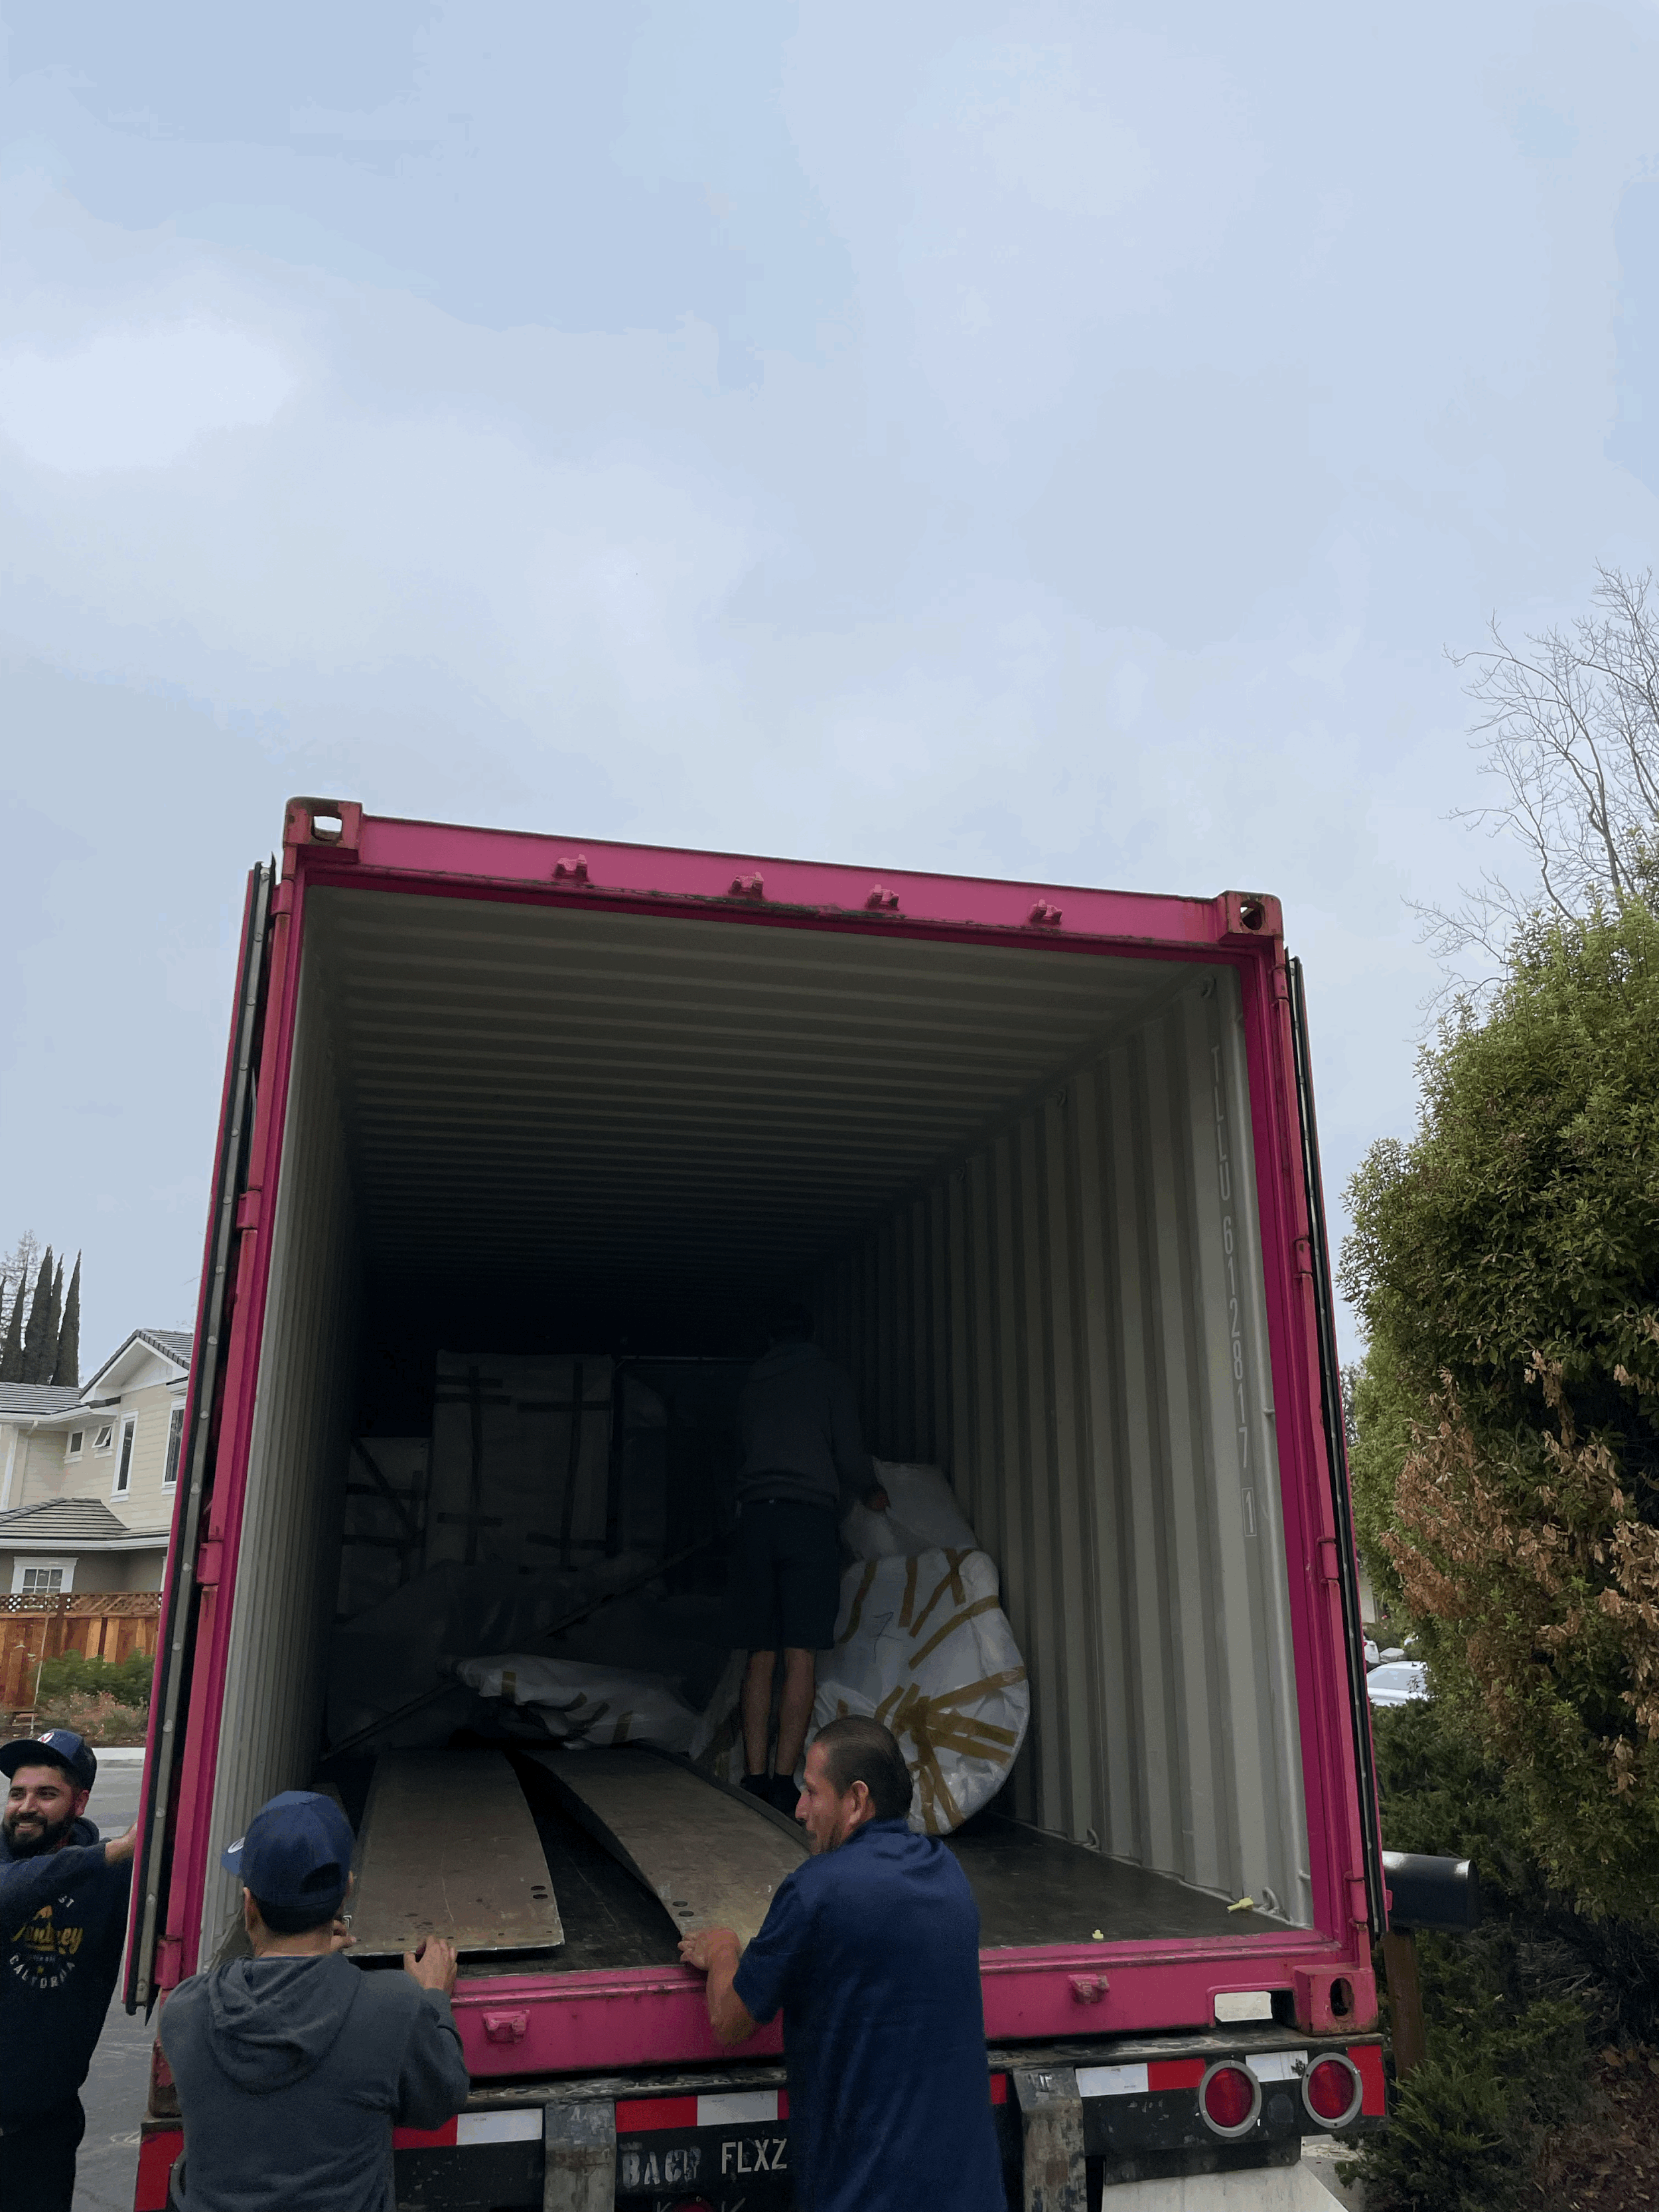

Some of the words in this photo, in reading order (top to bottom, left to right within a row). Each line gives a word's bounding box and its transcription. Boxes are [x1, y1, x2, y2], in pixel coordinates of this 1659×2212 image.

[1210, 1045, 1230, 1201] TLLU
[1223, 1215, 1248, 1469] 612817
[1244, 1490, 1255, 1534] 1
[9, 1954, 76, 1988] CALFORNA
[721, 2138, 788, 2175] FLXZ
